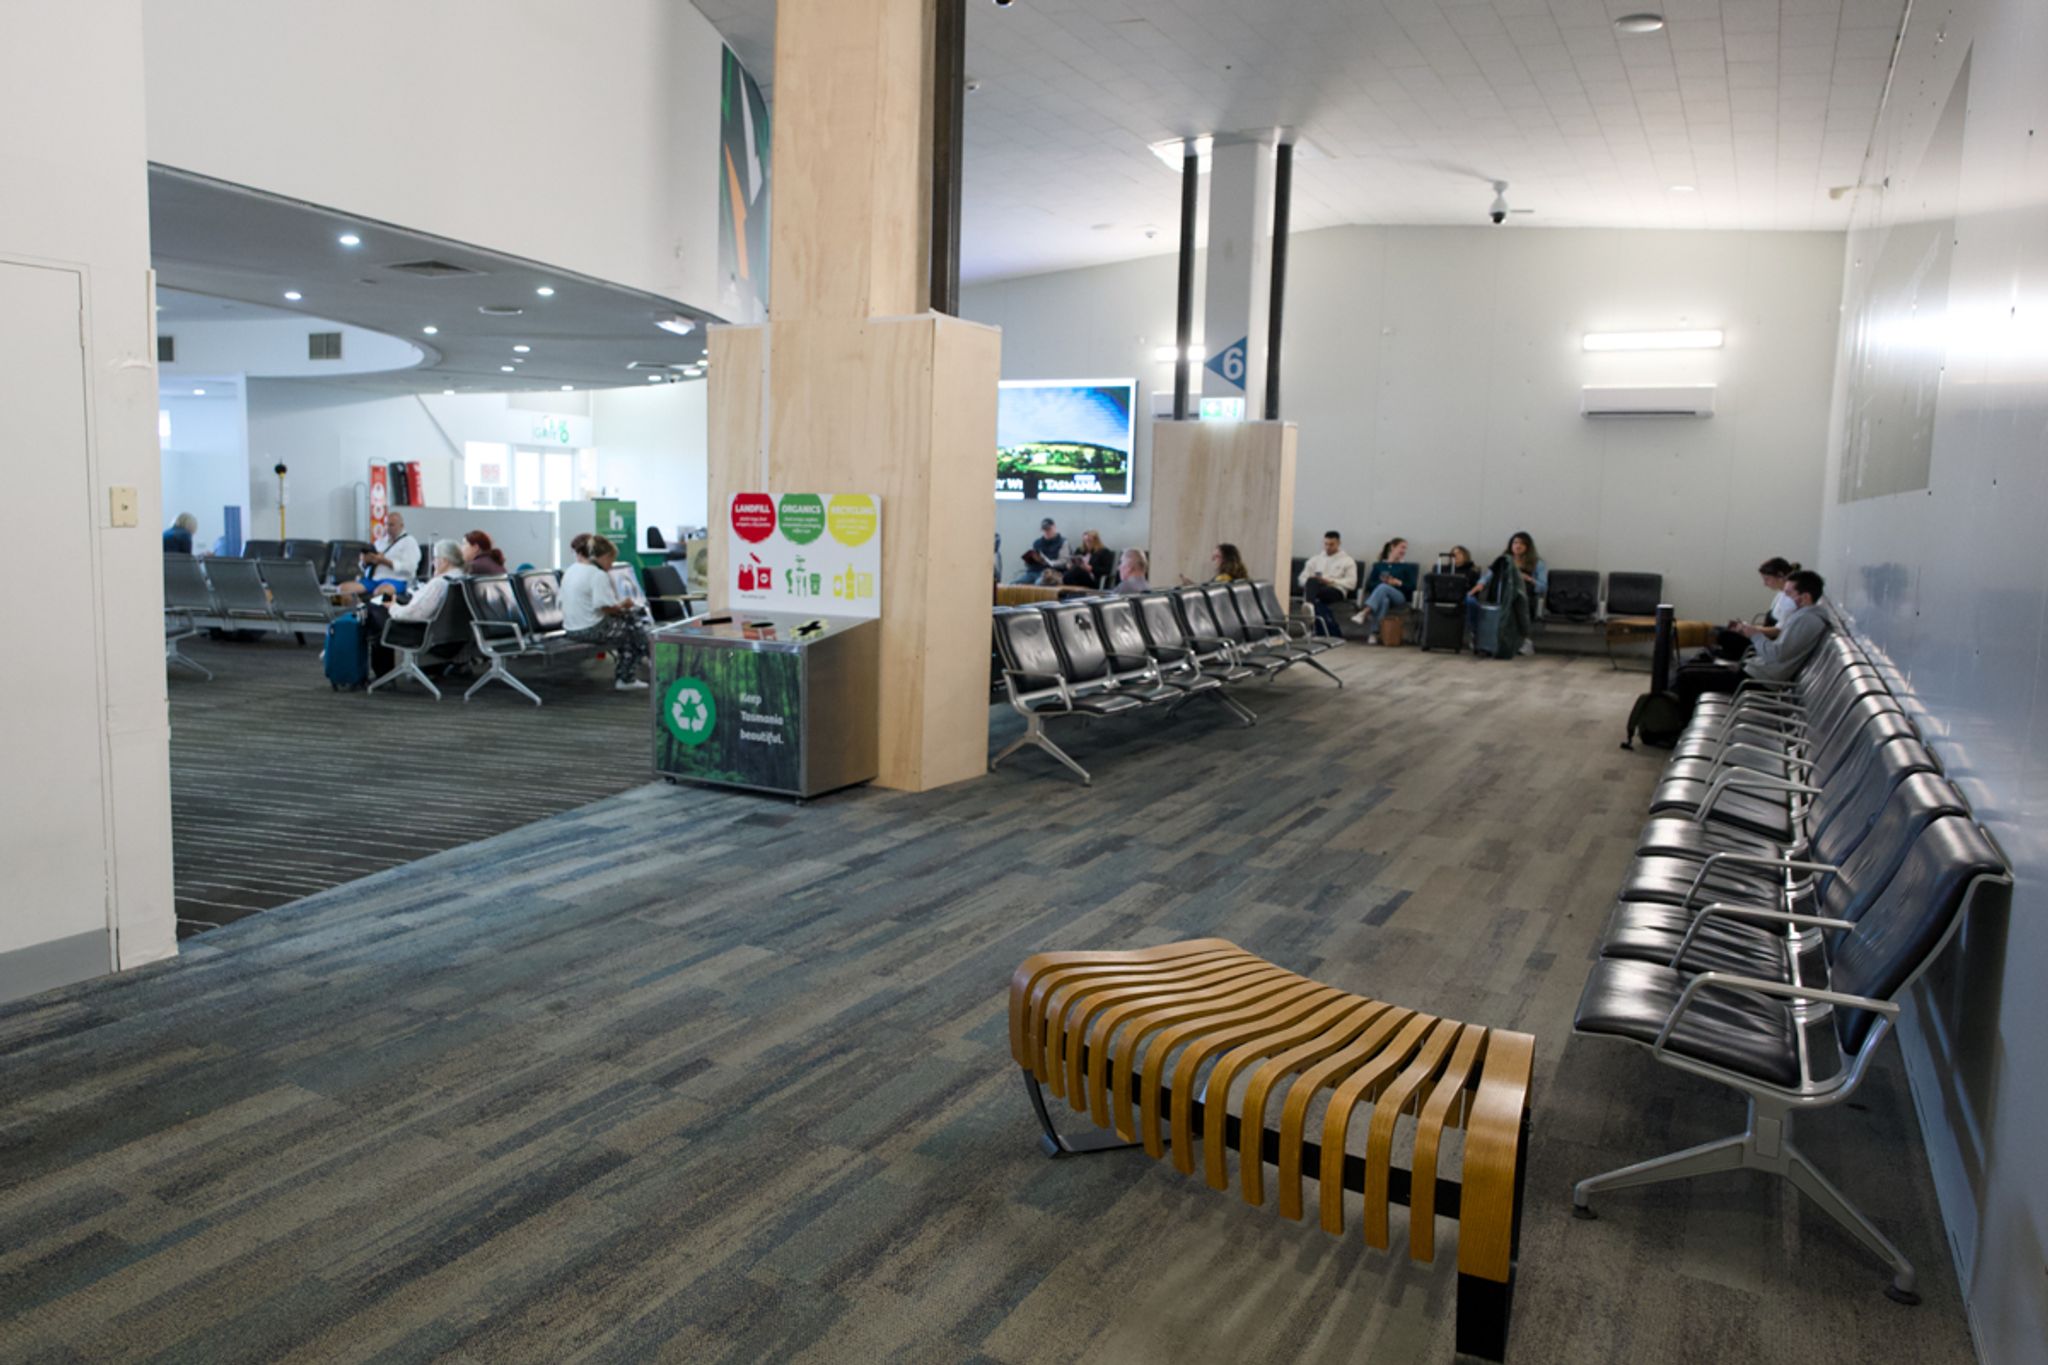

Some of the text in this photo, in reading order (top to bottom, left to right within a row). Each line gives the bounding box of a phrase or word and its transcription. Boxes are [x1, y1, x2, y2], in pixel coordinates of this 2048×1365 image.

[1223, 347, 1244, 380] 6
[1044, 479, 1103, 492] TASMANIA
[734, 504, 771, 514] LANDFILL
[781, 504, 821, 514] ORGANICS
[609, 509, 625, 530] h
[739, 692, 762, 706] Keep
[740, 710, 784, 726] Tasmania
[740, 728, 784, 745] beautiful.
